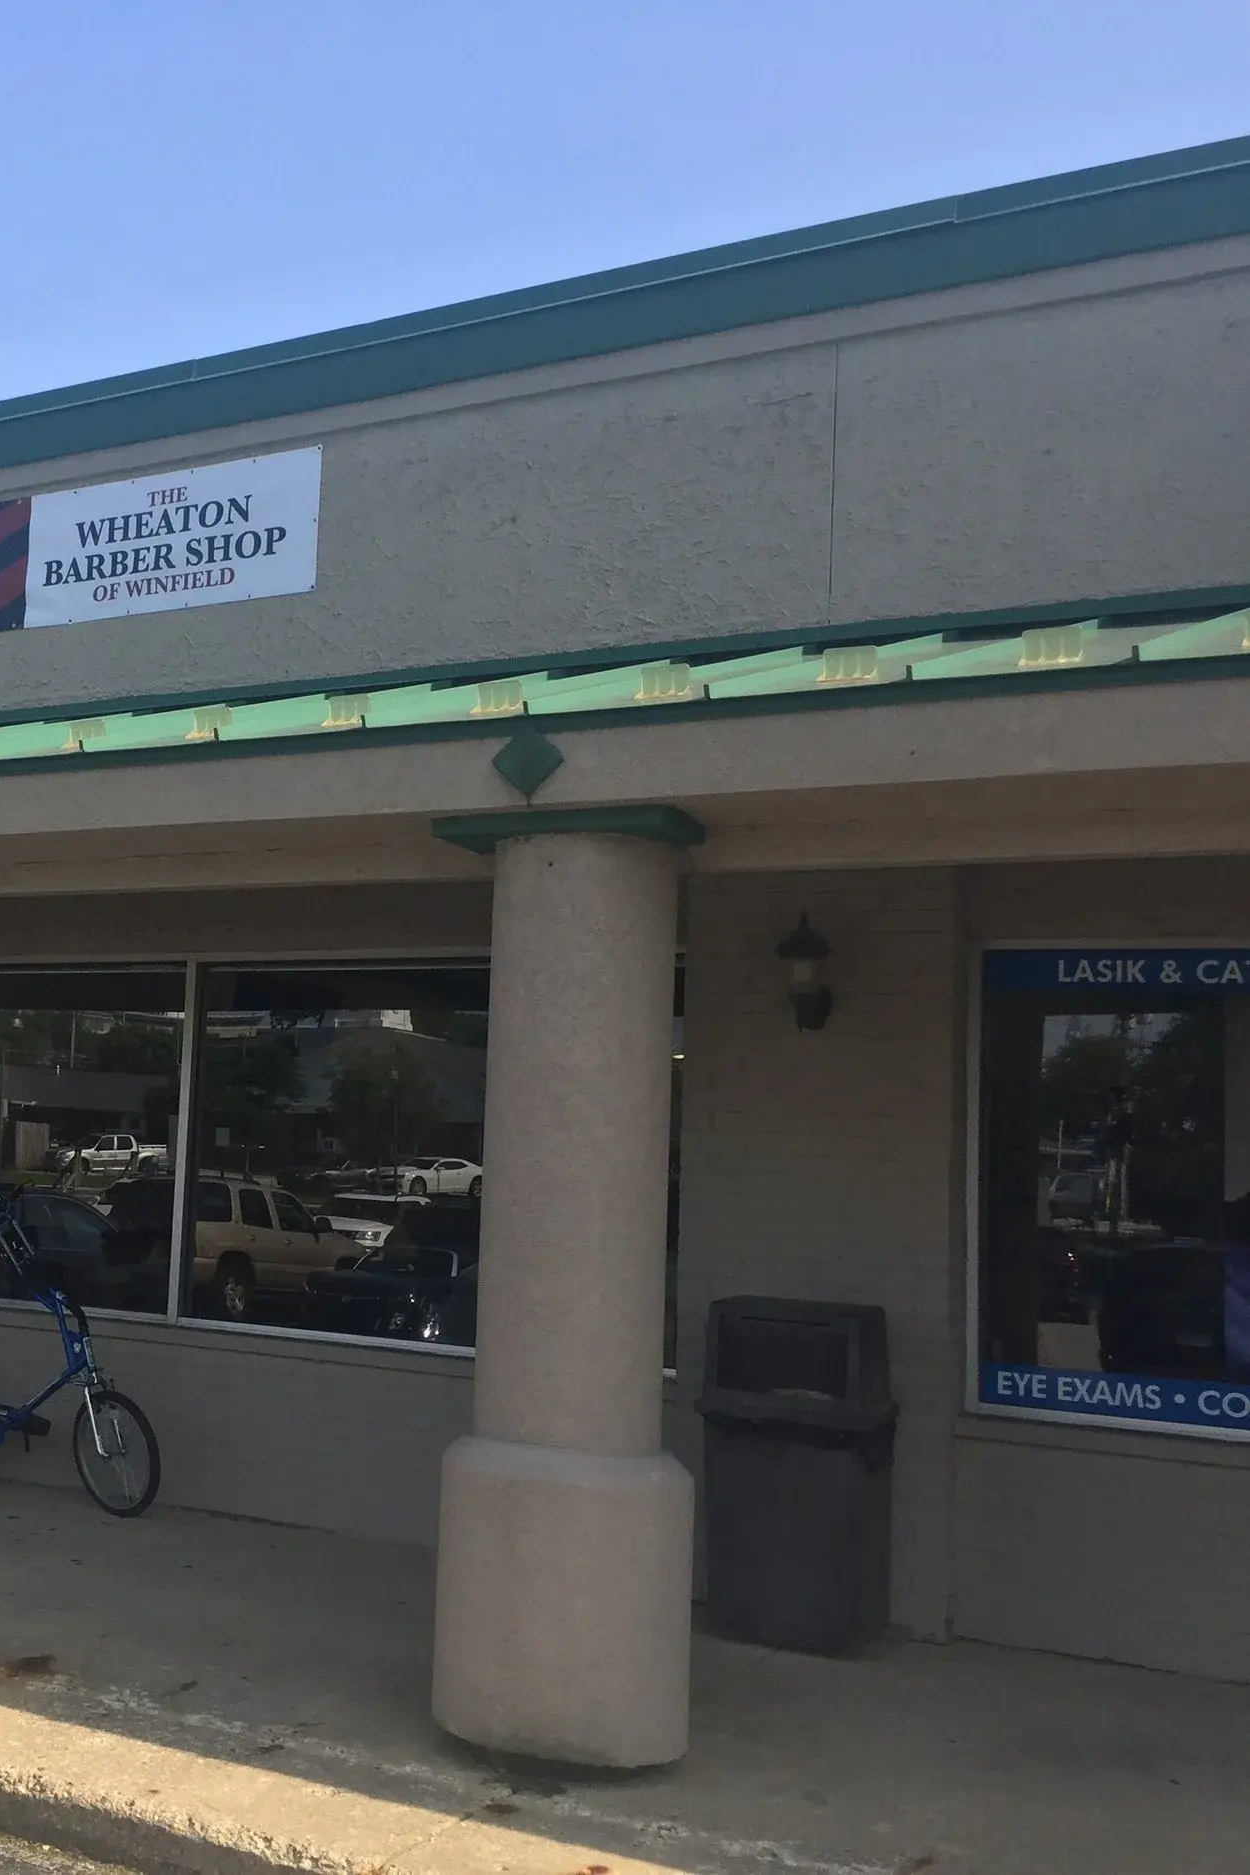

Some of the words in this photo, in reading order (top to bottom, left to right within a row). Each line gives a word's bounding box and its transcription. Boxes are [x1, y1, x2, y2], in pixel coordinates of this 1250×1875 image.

[147, 486, 188, 507] THE
[75, 495, 252, 549] WHEATON
[44, 543, 175, 587] BARBER
[185, 526, 287, 568] SHOP
[93, 582, 121, 602] OF
[122, 567, 235, 597] WINFIELD
[1057, 959, 1146, 984] LASIK
[1160, 960, 1183, 984] &
[1196, 959, 1250, 984] CA
[997, 1371, 1047, 1399] EYE
[1057, 1377, 1162, 1409] EXAMS
